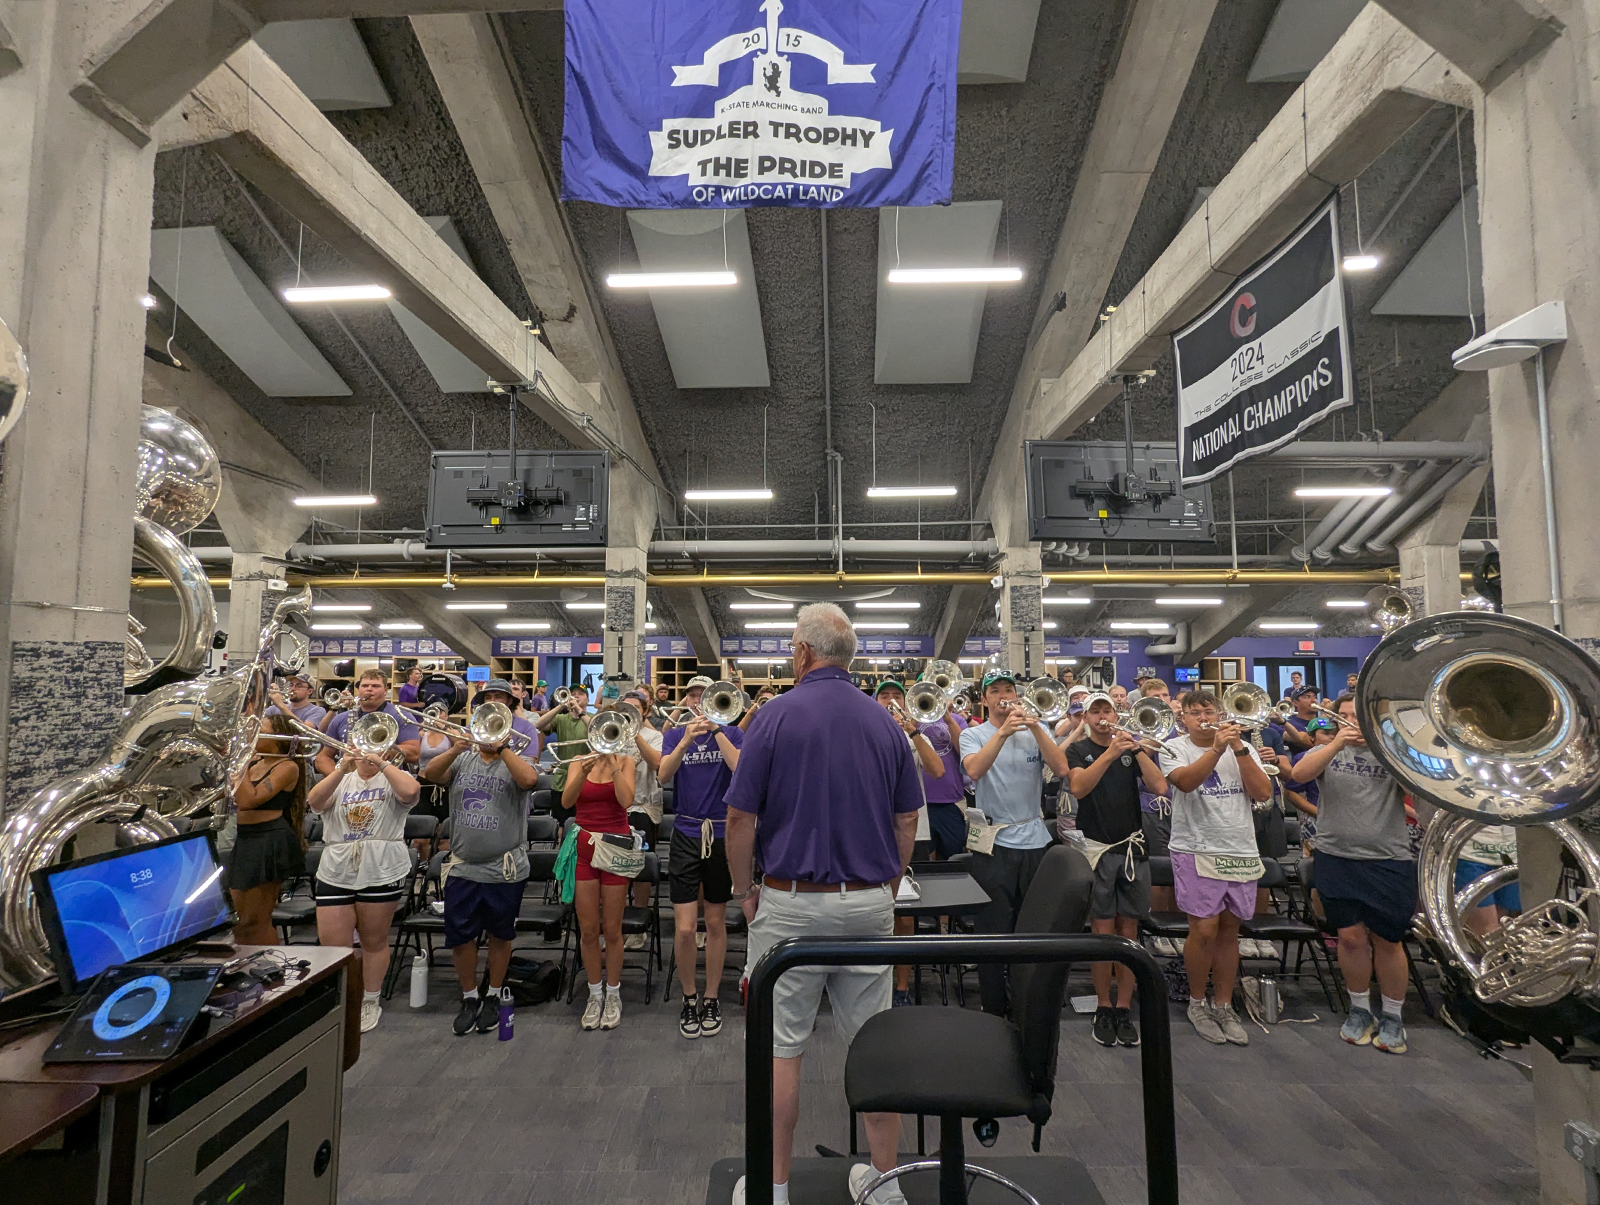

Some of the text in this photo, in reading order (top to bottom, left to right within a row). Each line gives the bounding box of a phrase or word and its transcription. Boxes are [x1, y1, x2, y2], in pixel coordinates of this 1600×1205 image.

[742, 33, 802, 50] 20 15
[720, 100, 824, 114] K-STATE MARCHING BAND
[667, 120, 876, 149] SUDLER TROPHY
[697, 155, 844, 180] THE PRIDE
[692, 184, 844, 203] OF WILDCAT LAND
[1230, 341, 1265, 383] 2024
[1194, 404, 1212, 418] THE
[1266, 330, 1322, 374] CLASSIC
[1192, 413, 1242, 462] NATIONAL
[457, 773, 505, 793] K-STATE
[1230, 787, 1244, 795] ERA
[130, 868, 153, 883] 8:38
